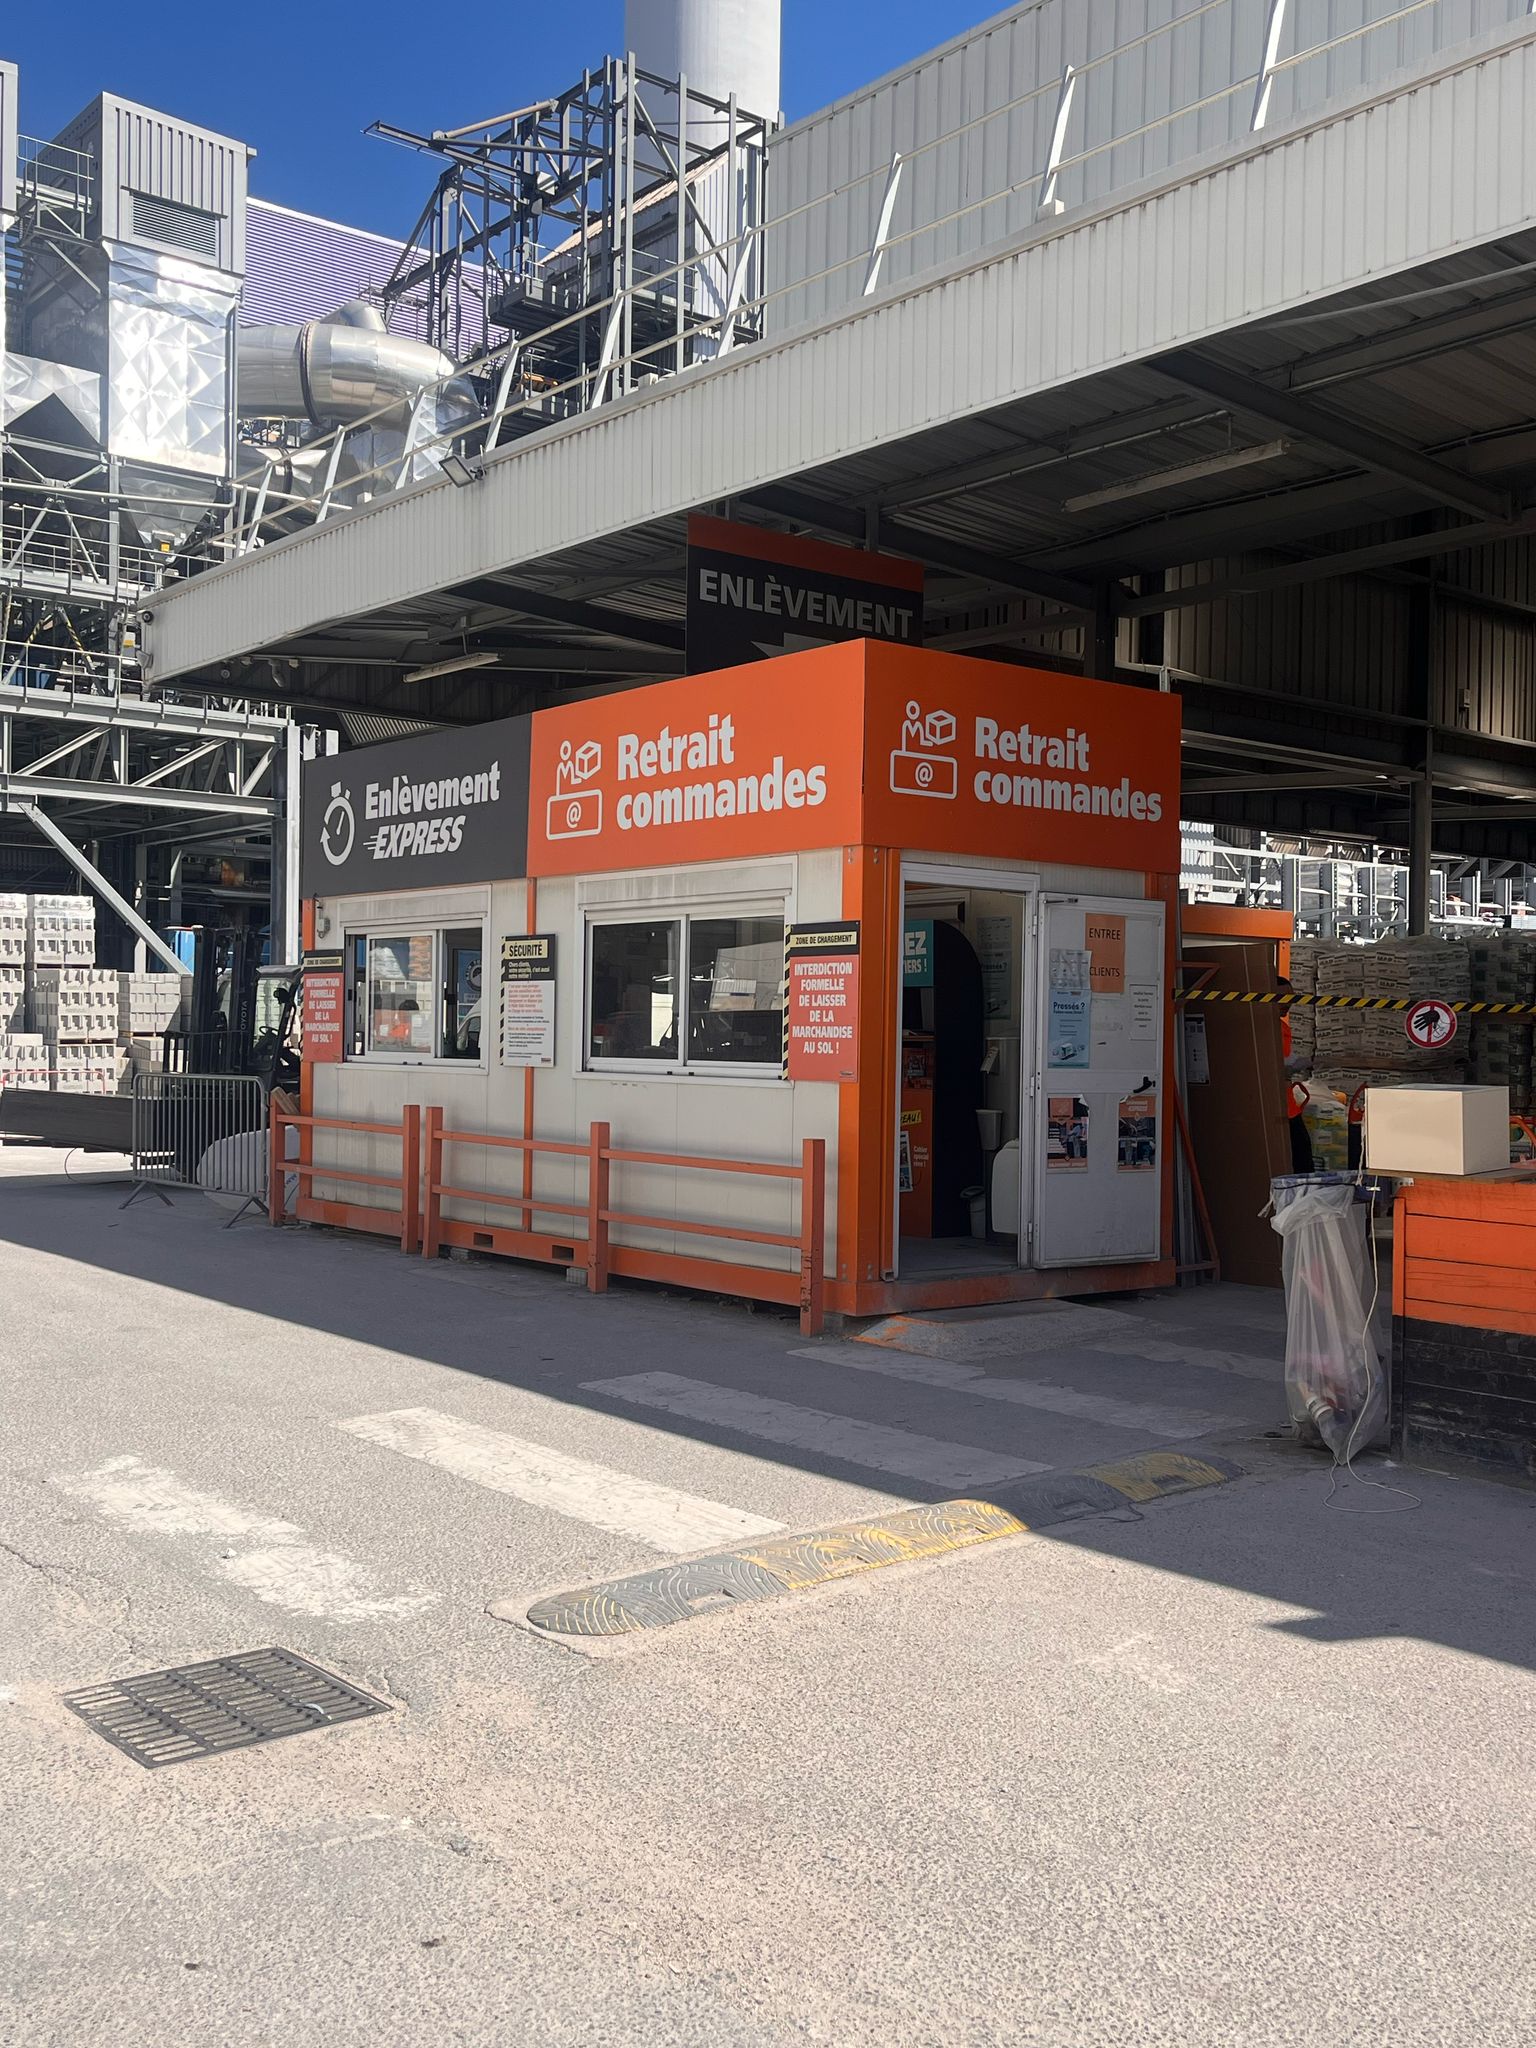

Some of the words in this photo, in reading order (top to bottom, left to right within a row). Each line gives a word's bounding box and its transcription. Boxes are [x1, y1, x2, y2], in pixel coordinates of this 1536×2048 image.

[699, 568, 913, 639] ENLÈVEMENT
[617, 713, 735, 781] Retrait
[975, 716, 1089, 772] Retrait
[365, 760, 500, 820] Enlèvement
[616, 755, 827, 831] commandes
[974, 770, 1162, 822] commandes
[370, 815, 467, 860] EXPRESS
[796, 937, 809, 945] ZONE
[810, 936, 816, 944] DE
[817, 934, 852, 944] CHARGEMENT
[1089, 928, 1121, 940] ENTREE
[509, 941, 542, 957] SÉCURITÉ
[904, 931, 927, 956] EZ
[795, 962, 852, 976] INTERDICTION
[903, 958, 921, 974] IERS
[1089, 966, 1121, 977] CLIENTS
[801, 978, 844, 991] FORMELLE
[309, 1001, 316, 1009] DE
[799, 995, 809, 1007] DE
[811, 994, 846, 1007] LAISSER
[1053, 1001, 1080, 1010] Pressés
[315, 1012, 322, 1020] DE
[322, 1012, 329, 1020] LA
[810, 1010, 821, 1022] DE
[822, 1010, 834, 1022] LA
[792, 1026, 853, 1039] MARCHANDISE
[803, 1042, 816, 1054] AU
[817, 1042, 833, 1054] SOL
[900, 1113, 919, 1123] EAU!
